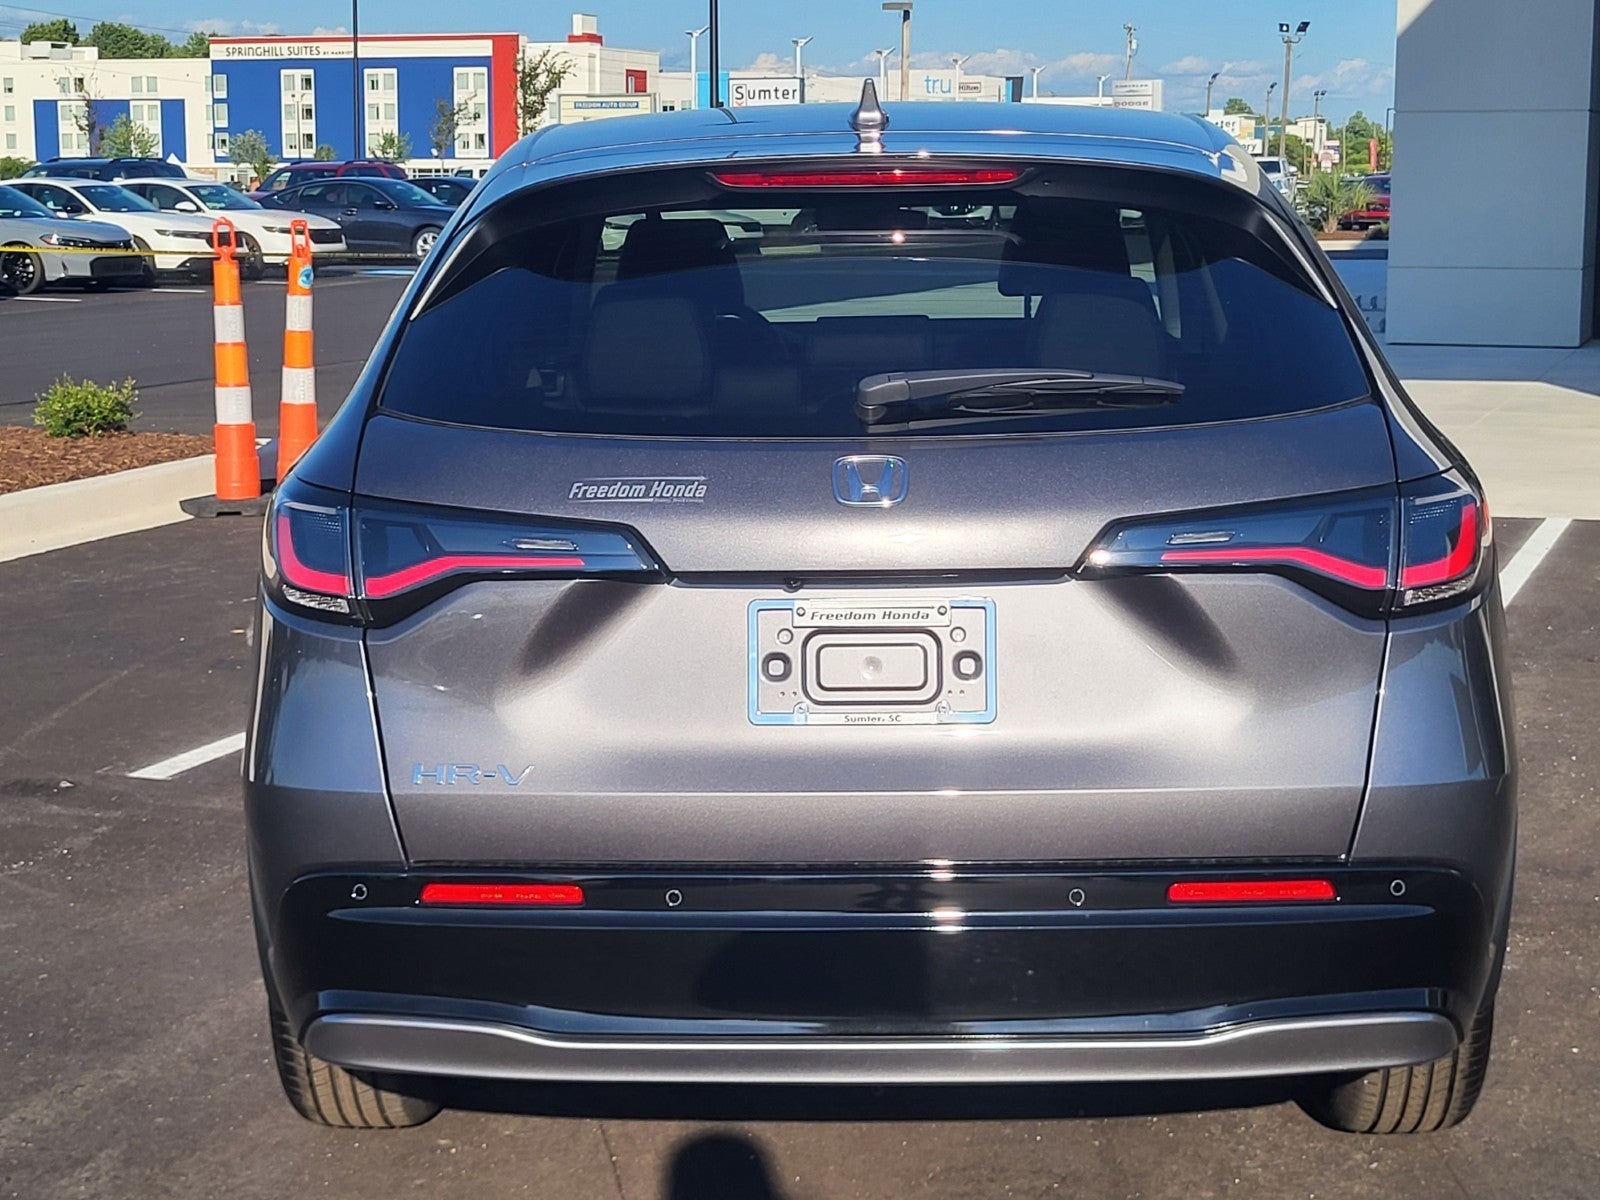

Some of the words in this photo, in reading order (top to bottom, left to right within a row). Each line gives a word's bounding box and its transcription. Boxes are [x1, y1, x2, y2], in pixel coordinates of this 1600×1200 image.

[287, 45, 321, 56] SUITES
[924, 75, 952, 94] tru
[735, 85, 798, 100] Sumter
[568, 481, 647, 499] Freedom
[649, 481, 707, 498] Honda
[810, 611, 876, 621] Freedom
[881, 610, 930, 620] Honda
[888, 714, 902, 723] SC
[412, 763, 535, 786] HR-V
